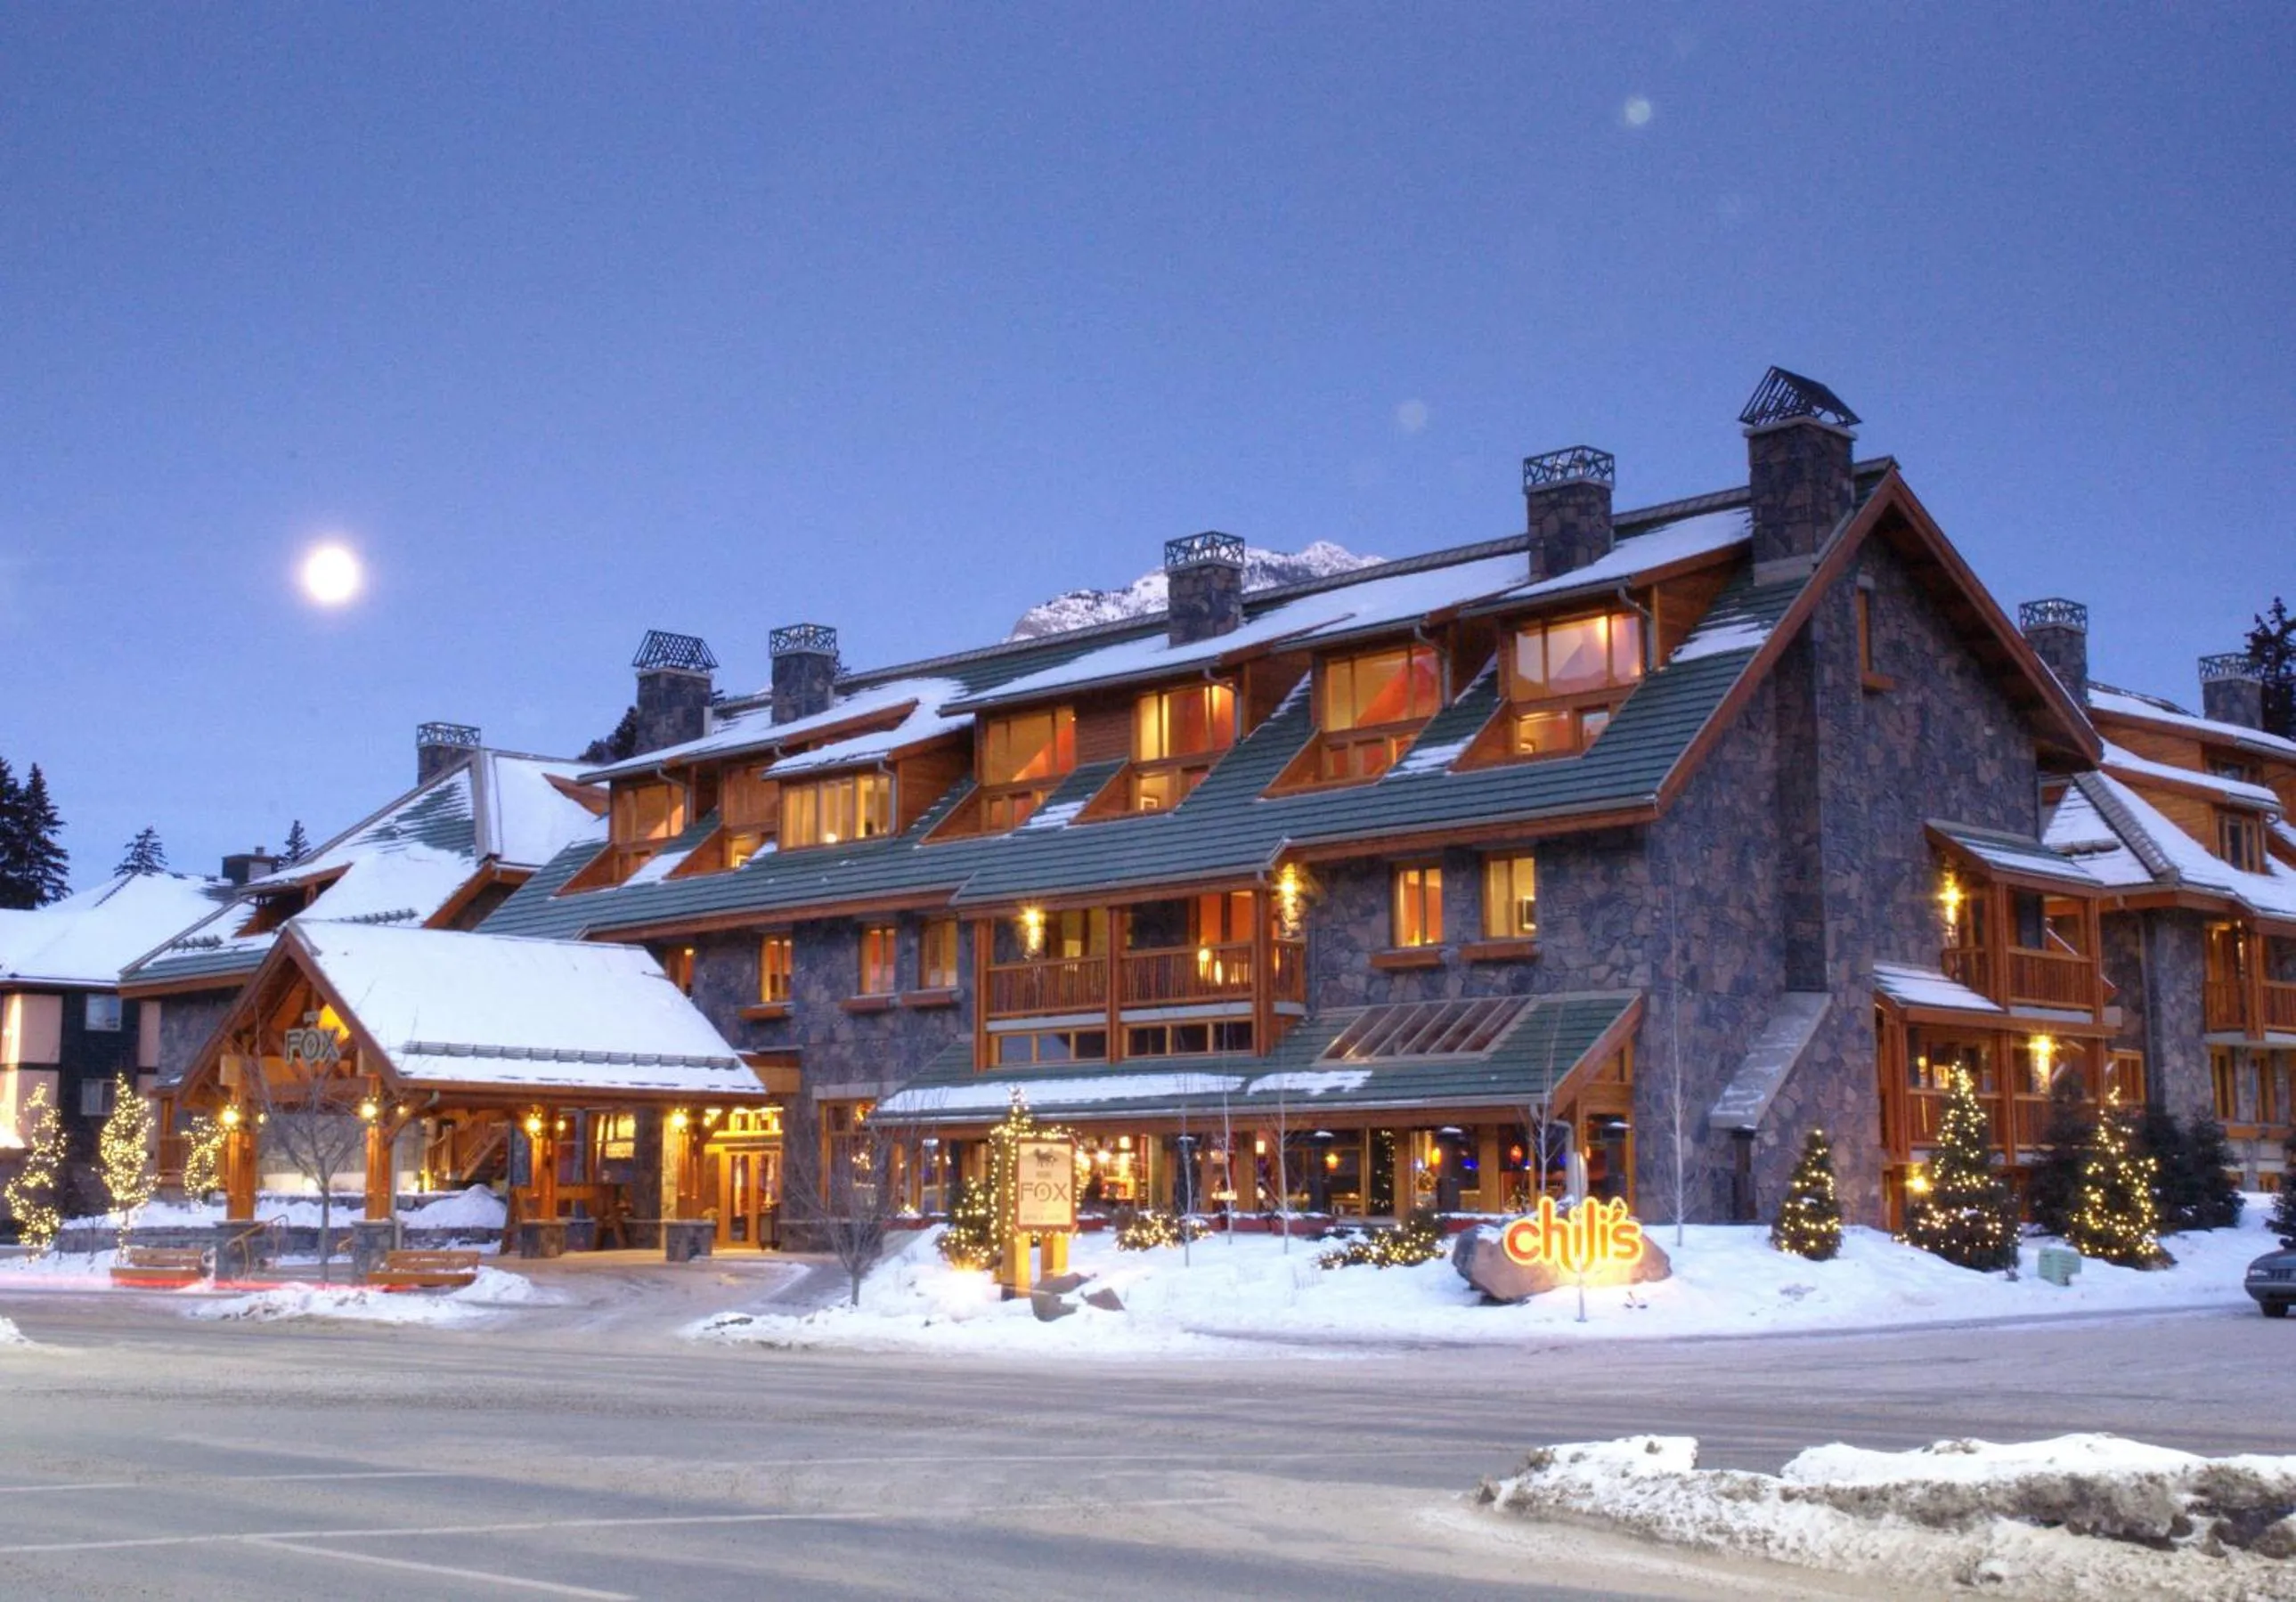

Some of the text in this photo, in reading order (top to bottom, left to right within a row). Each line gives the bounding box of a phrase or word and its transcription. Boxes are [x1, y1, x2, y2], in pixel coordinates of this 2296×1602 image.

[286, 1029, 340, 1064] FOX
[1021, 1181, 1069, 1202] FOX
[1505, 1197, 1641, 1273] chili's
